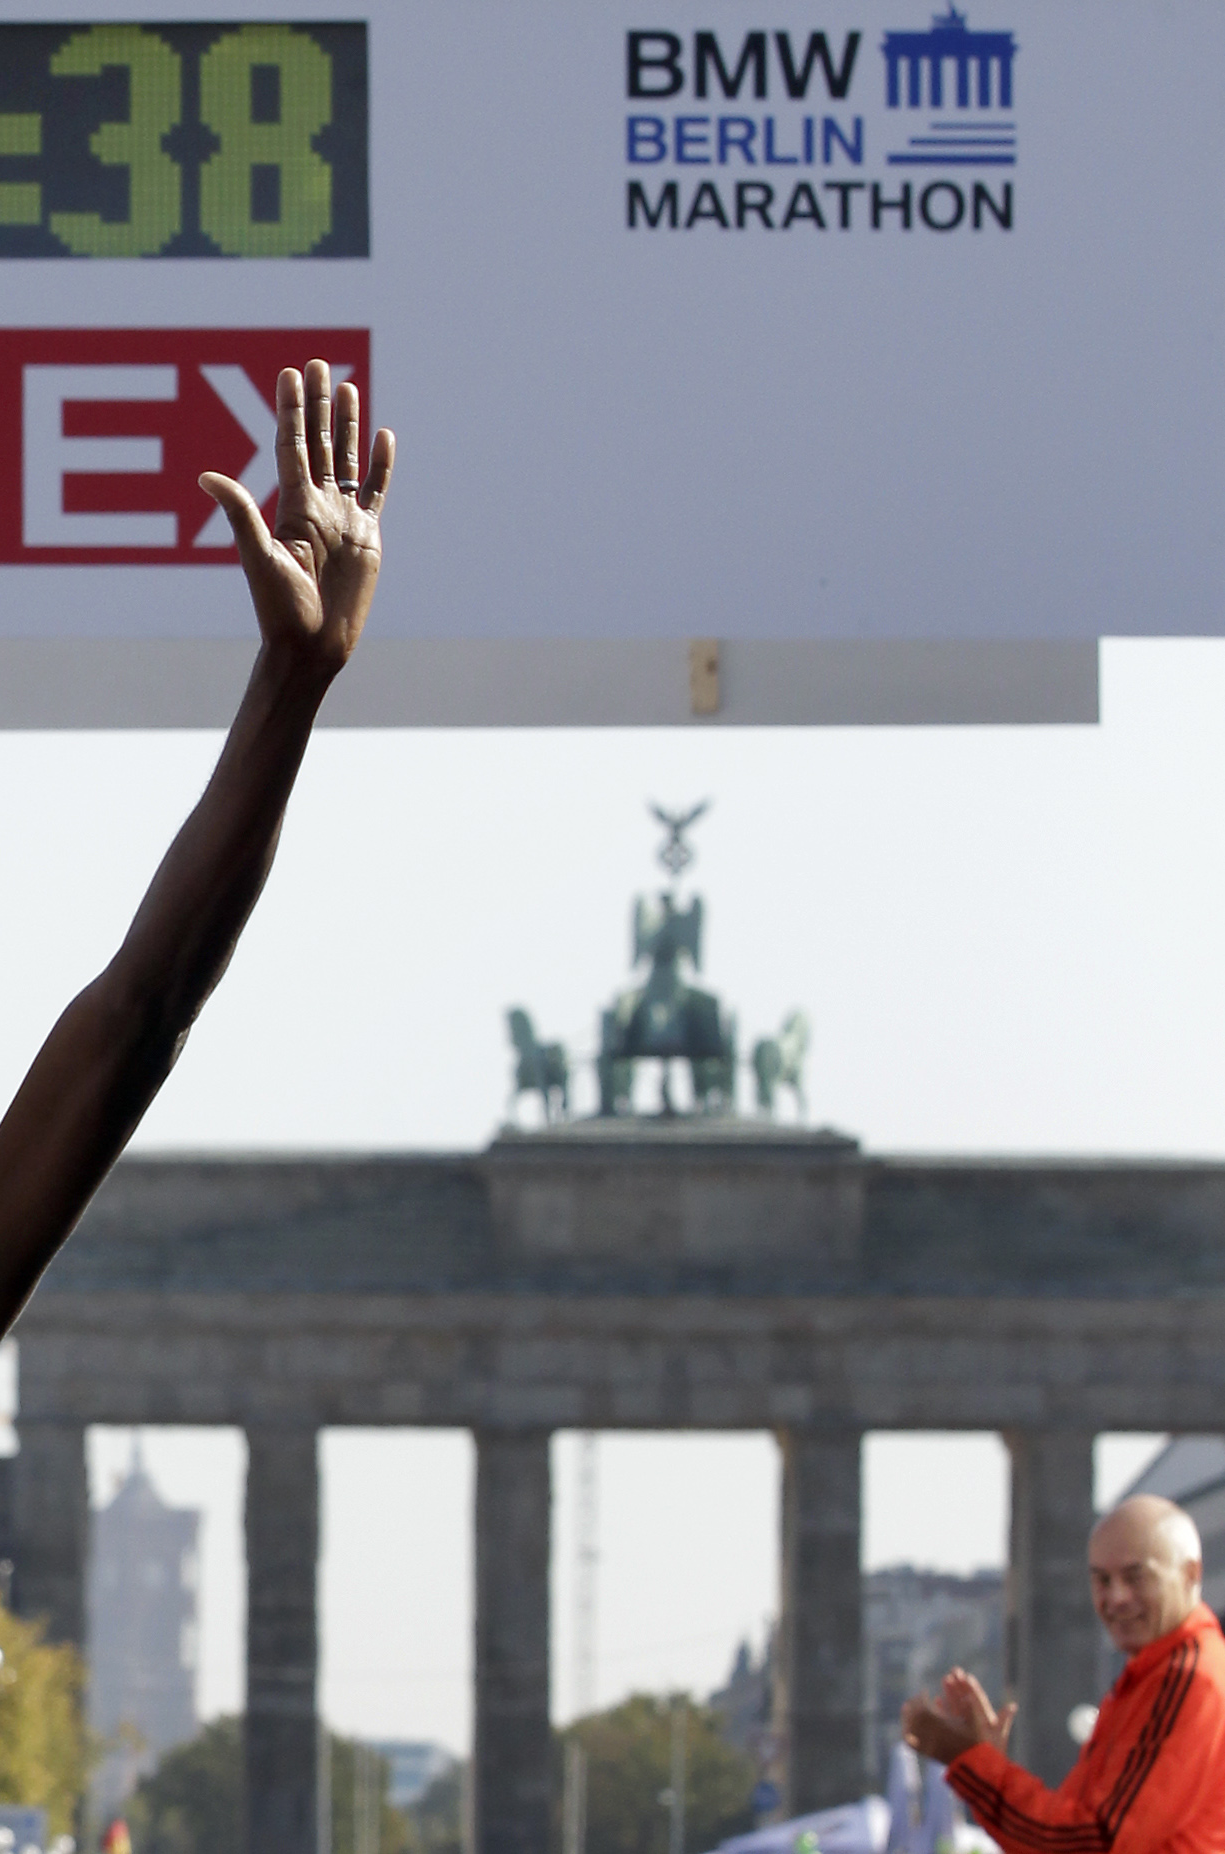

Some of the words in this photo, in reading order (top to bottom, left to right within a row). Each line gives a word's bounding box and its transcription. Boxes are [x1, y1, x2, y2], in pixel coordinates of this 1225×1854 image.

[626, 31, 862, 100] BMW
[626, 116, 864, 165] BERLIN
[626, 181, 1014, 232] MARATHON
